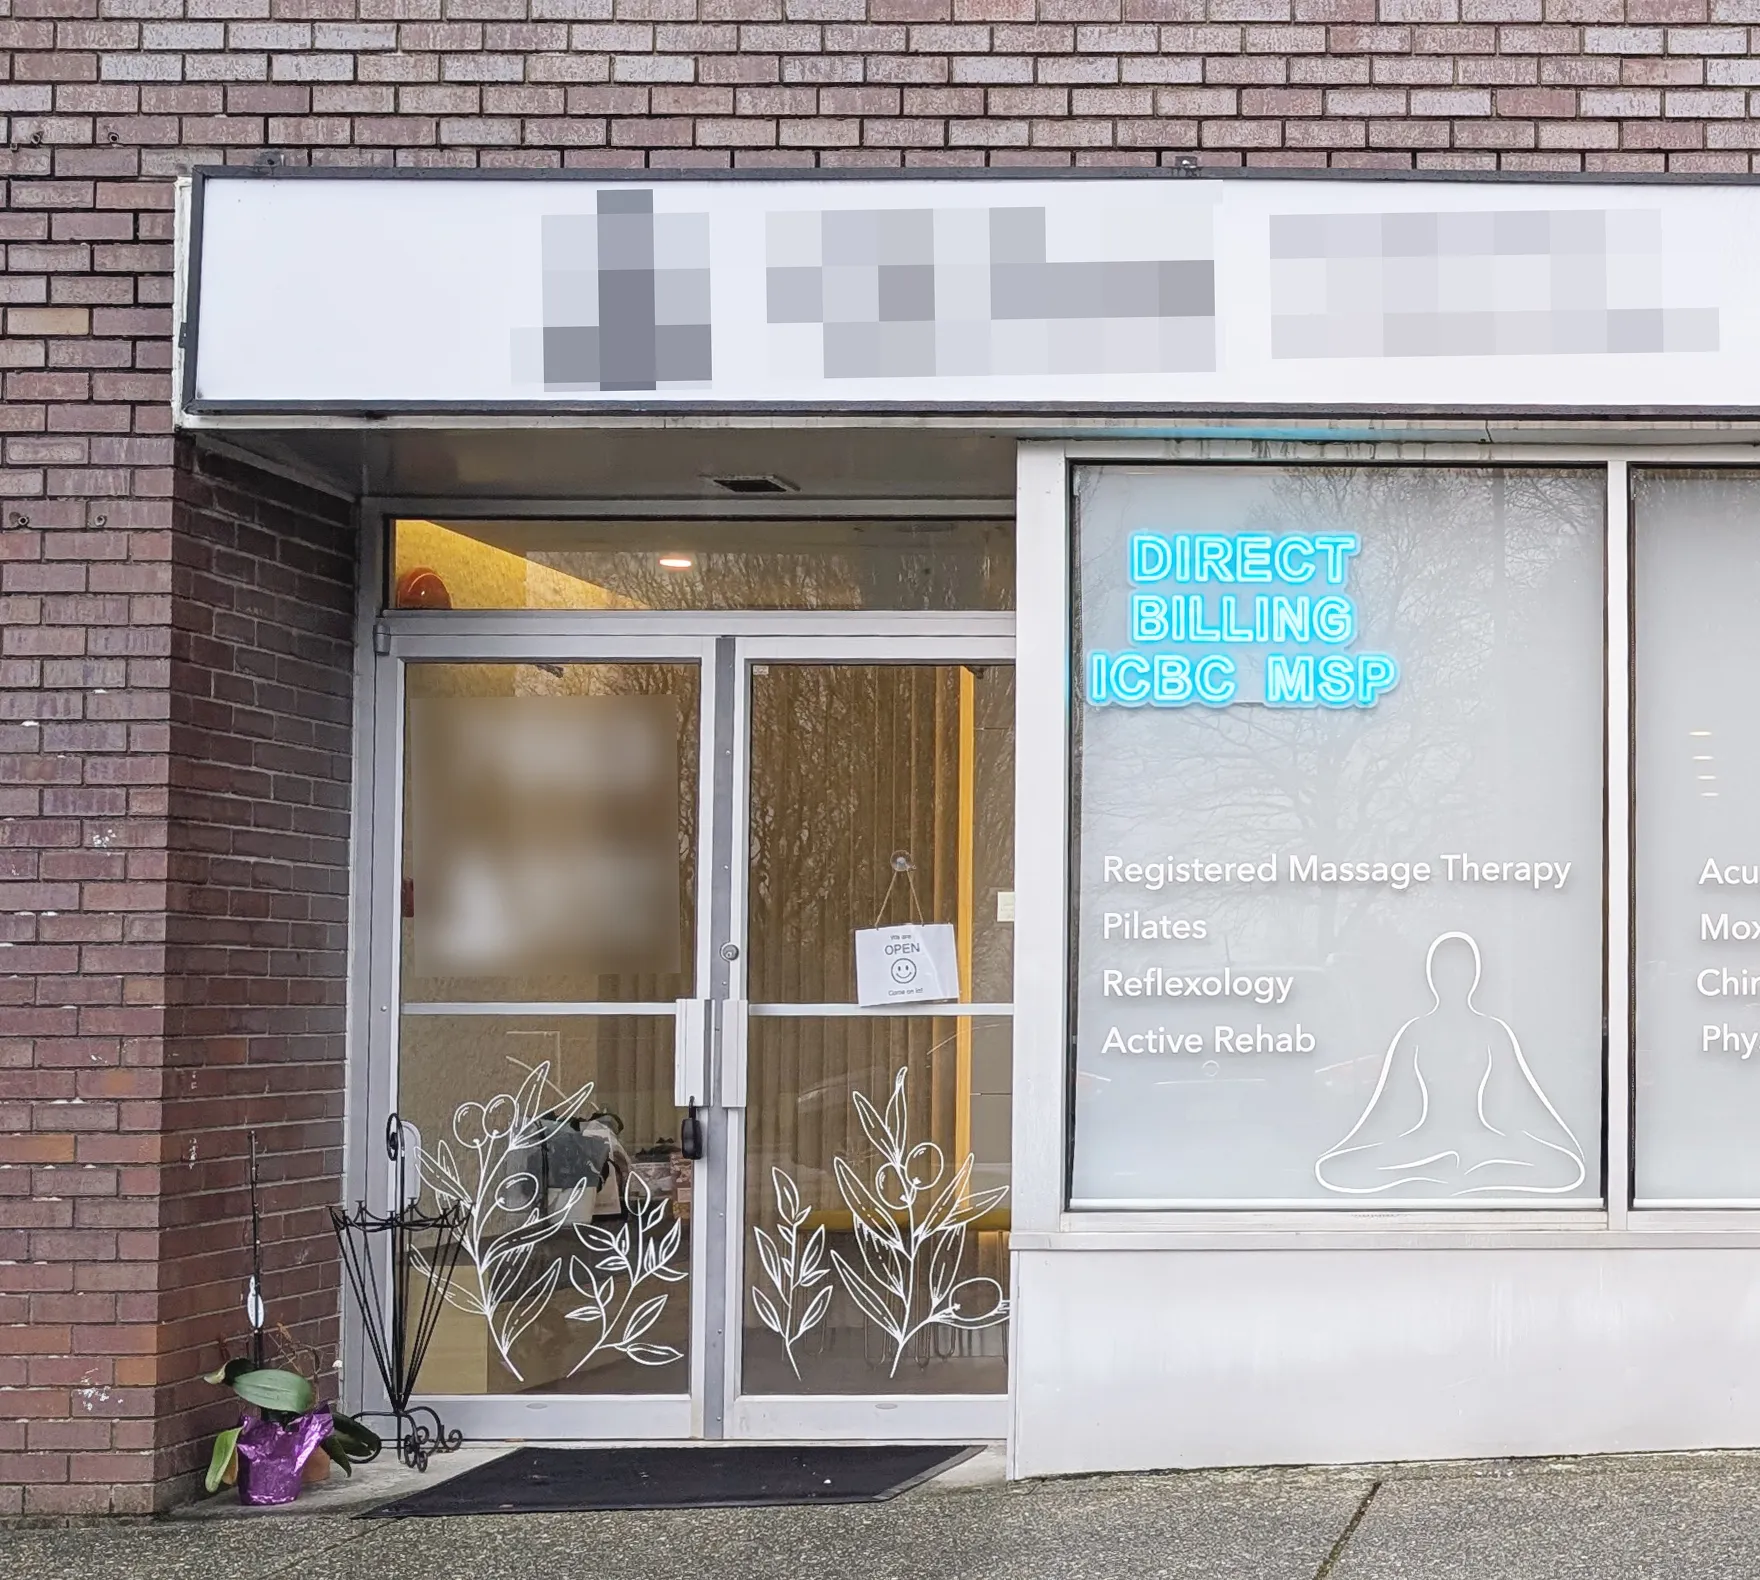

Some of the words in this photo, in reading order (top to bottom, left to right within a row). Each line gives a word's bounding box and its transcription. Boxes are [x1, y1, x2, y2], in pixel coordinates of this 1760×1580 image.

[1132, 534, 1358, 584] DIRECT
[1131, 594, 1353, 643] BILLING
[1091, 653, 1236, 702] ICBC
[1266, 654, 1396, 704] MSP
[1103, 853, 1278, 891] Registered
[1288, 853, 1431, 890] Massage
[1440, 852, 1573, 889] Therapy
[1103, 910, 1208, 940] Pilates
[884, 943, 920, 955] OPEN
[1103, 966, 1295, 1005] Reflexology
[1101, 1026, 1203, 1055] Active
[1214, 1023, 1317, 1053] Rehab
